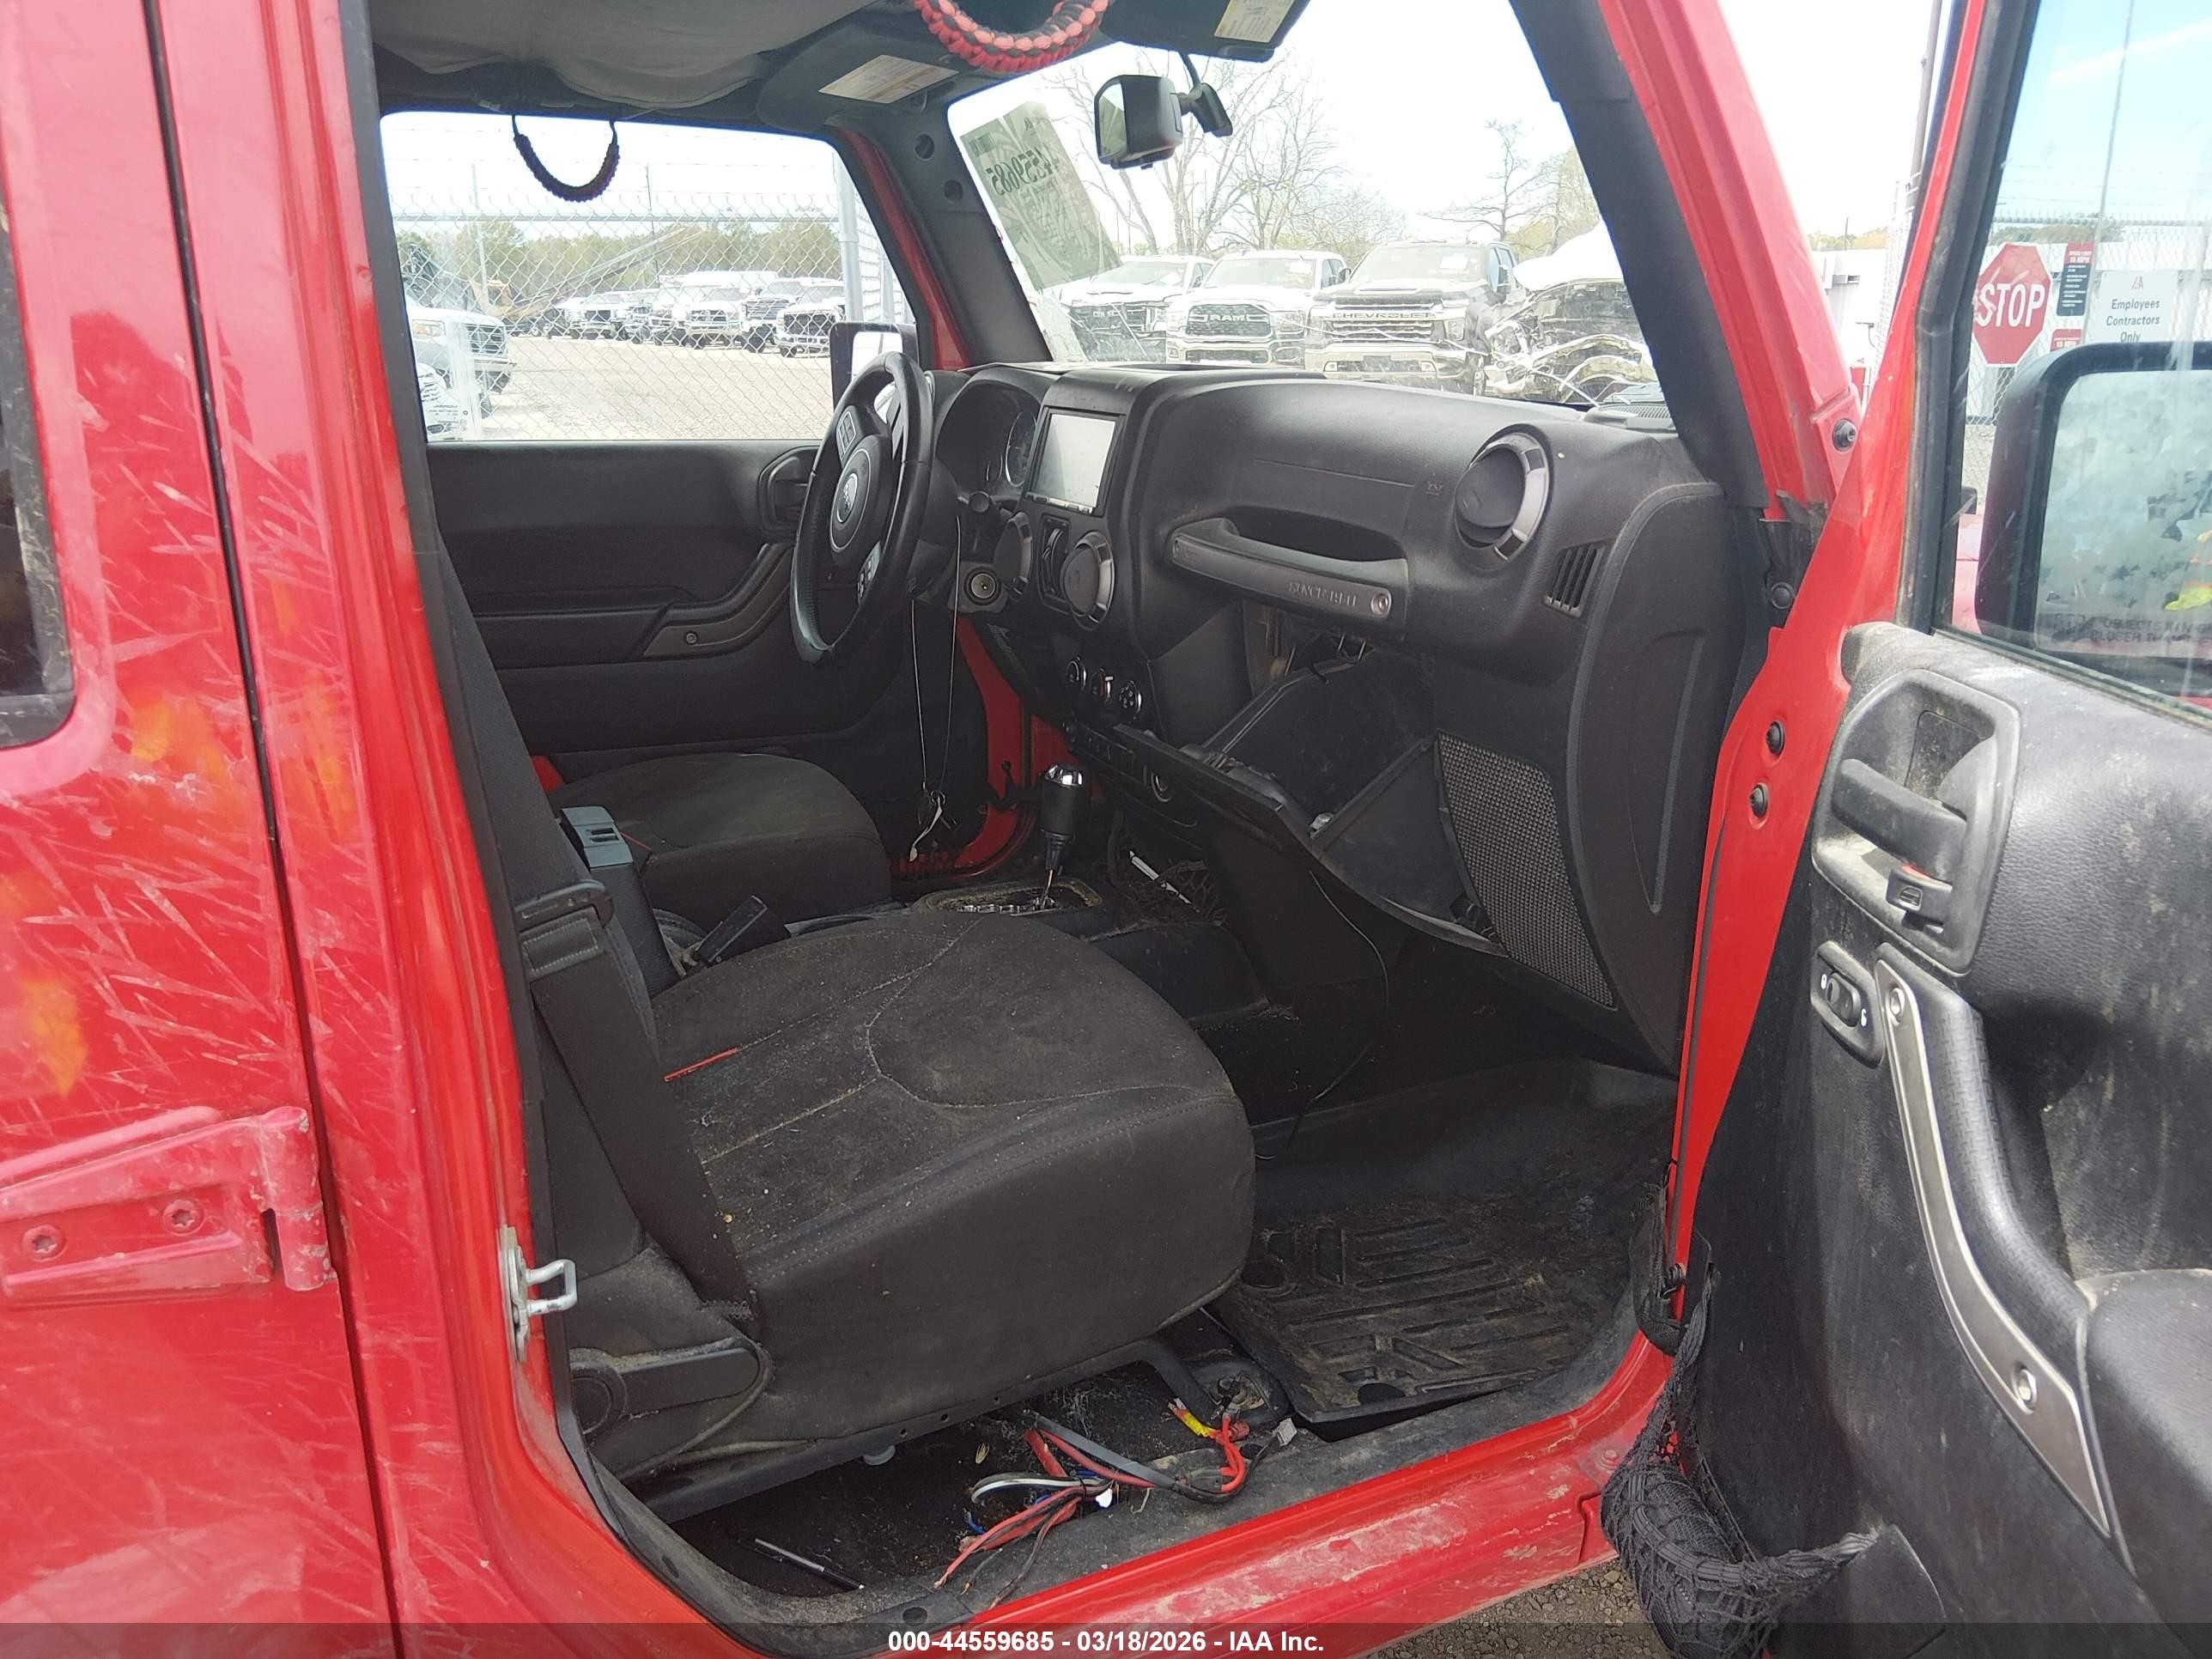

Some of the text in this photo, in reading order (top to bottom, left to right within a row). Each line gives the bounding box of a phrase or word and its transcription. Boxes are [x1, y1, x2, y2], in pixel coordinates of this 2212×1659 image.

[1973, 283, 2045, 327] STOP
[2111, 298, 2160, 312] Employees
[2106, 315, 2160, 326] Contractors
[2120, 331, 2141, 343] Only
